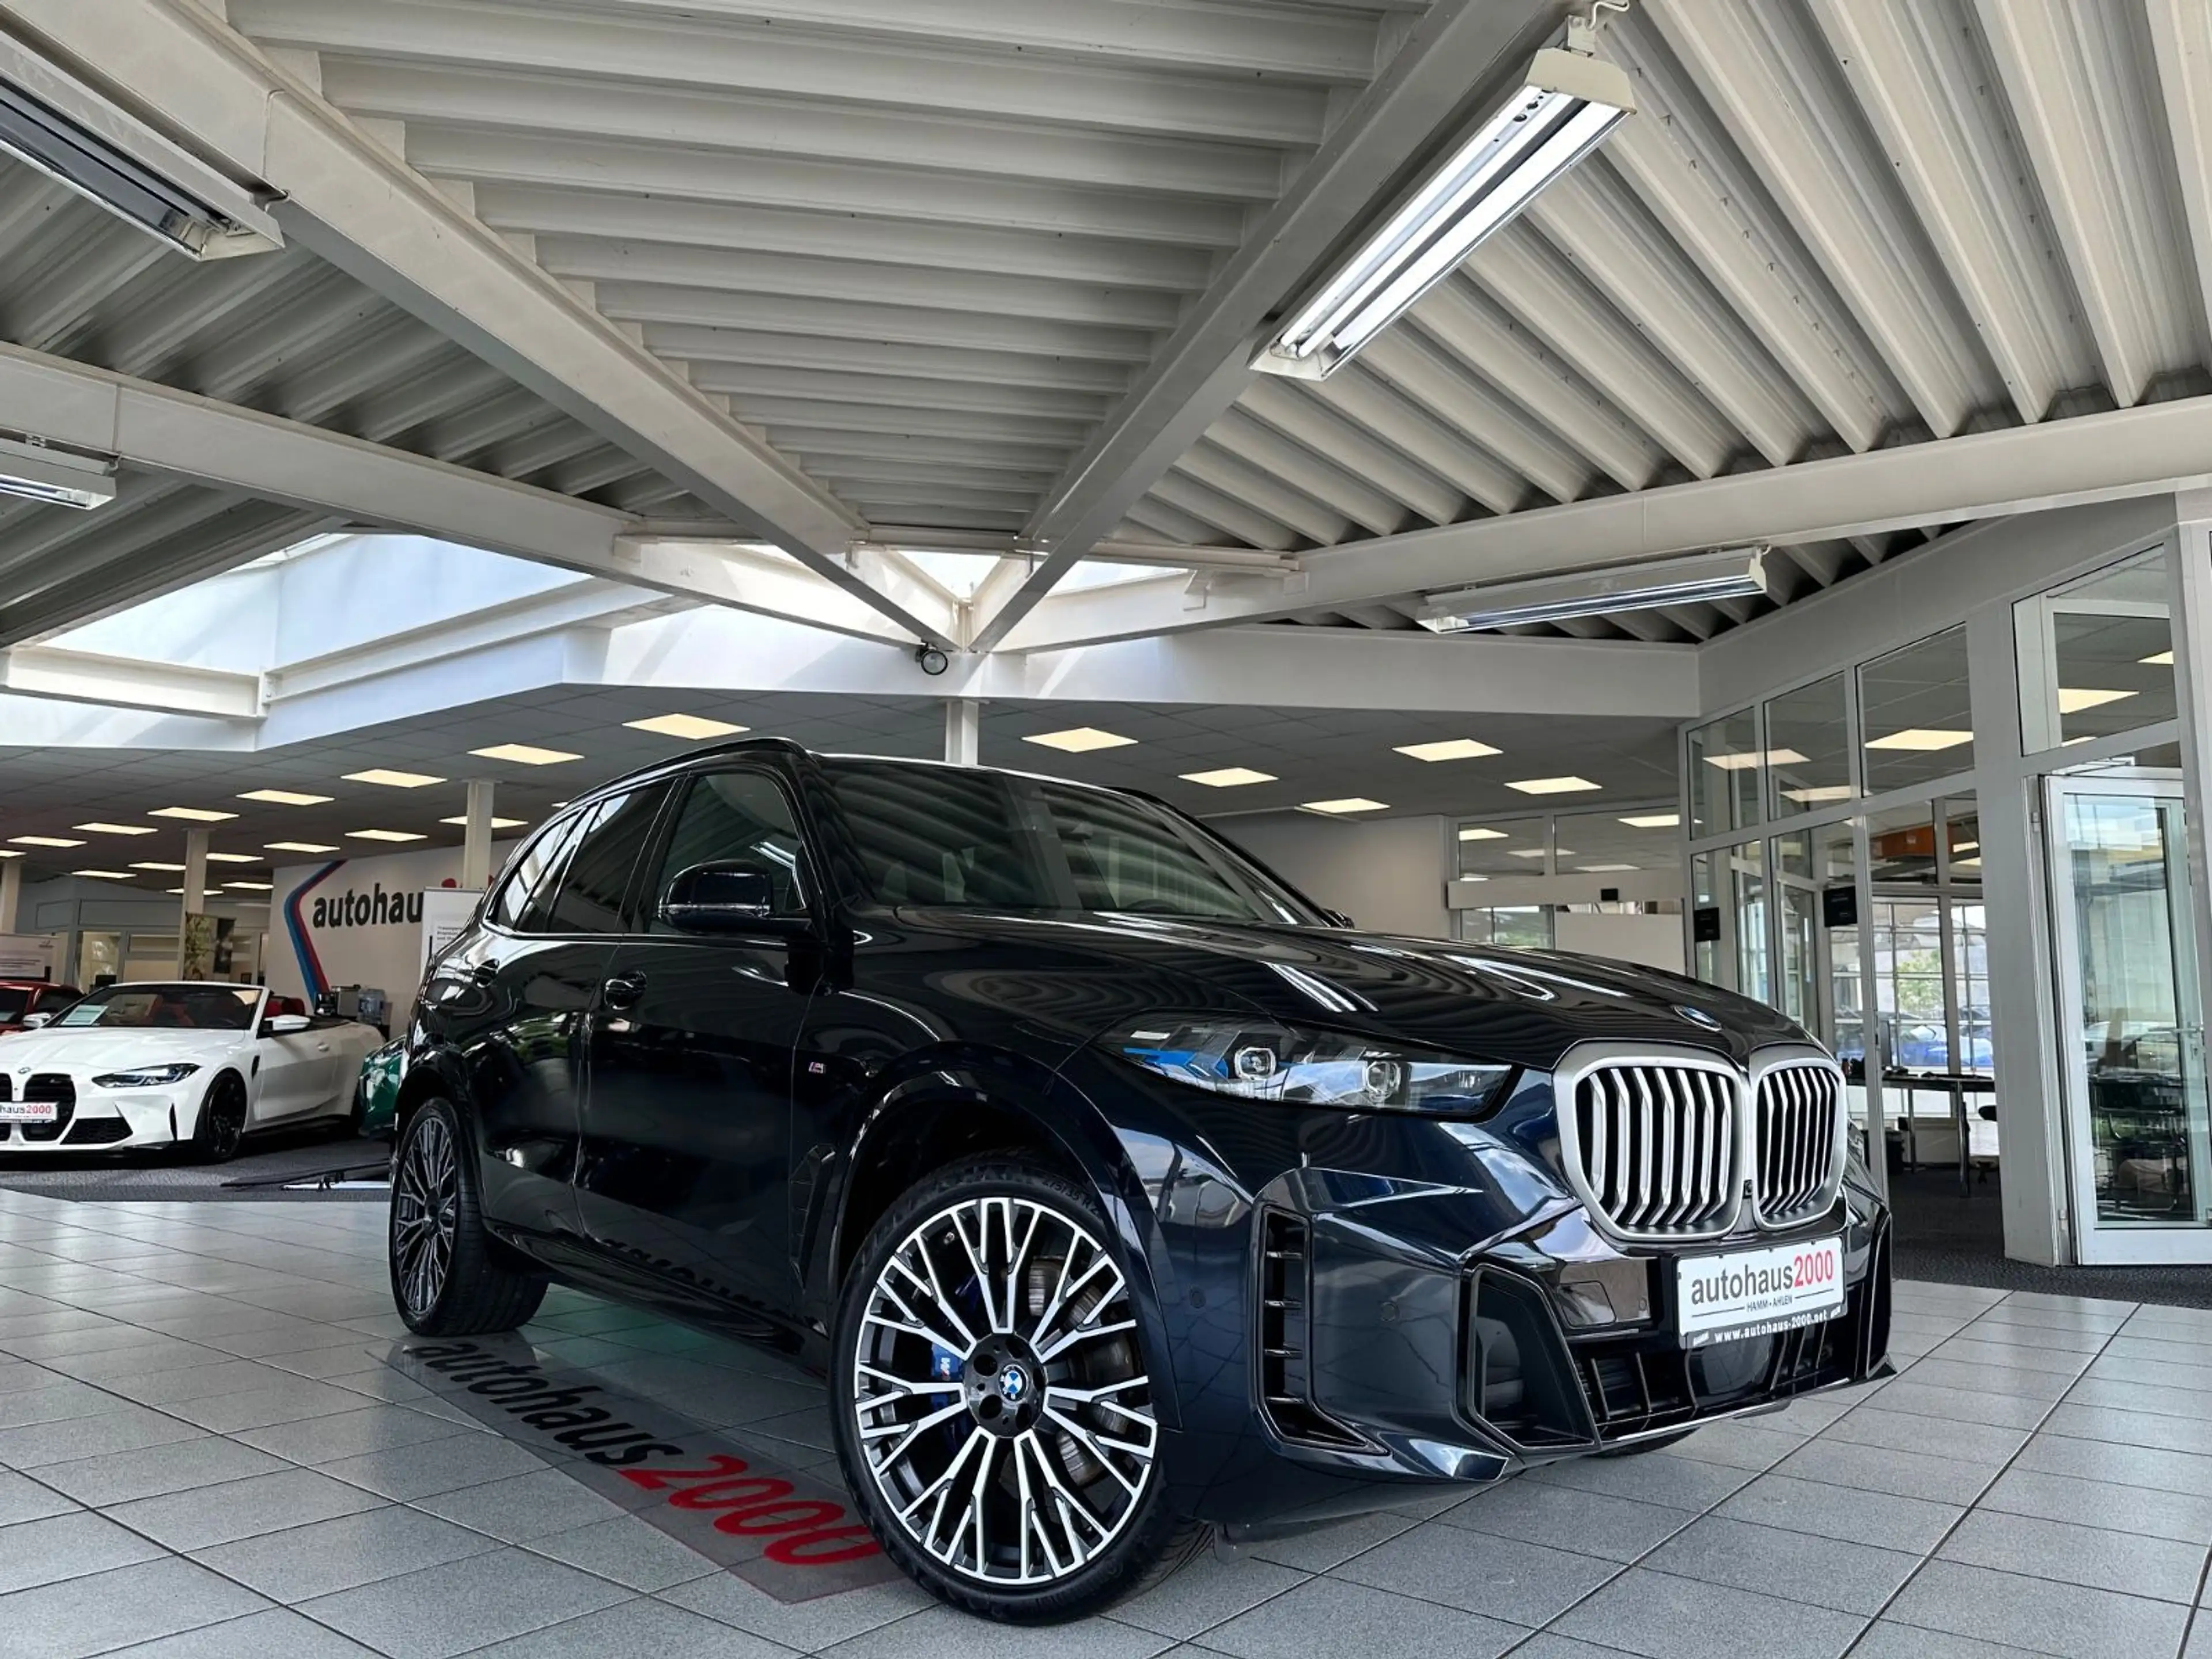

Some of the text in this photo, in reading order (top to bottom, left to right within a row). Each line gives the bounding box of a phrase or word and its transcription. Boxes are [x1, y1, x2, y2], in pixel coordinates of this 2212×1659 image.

[313, 882, 423, 928] autohau
[0, 1104, 52, 1114] haus2000
[1691, 1249, 1834, 1305] autohaus2000
[1714, 1309, 1828, 1344] www.autohaus-2000.net
